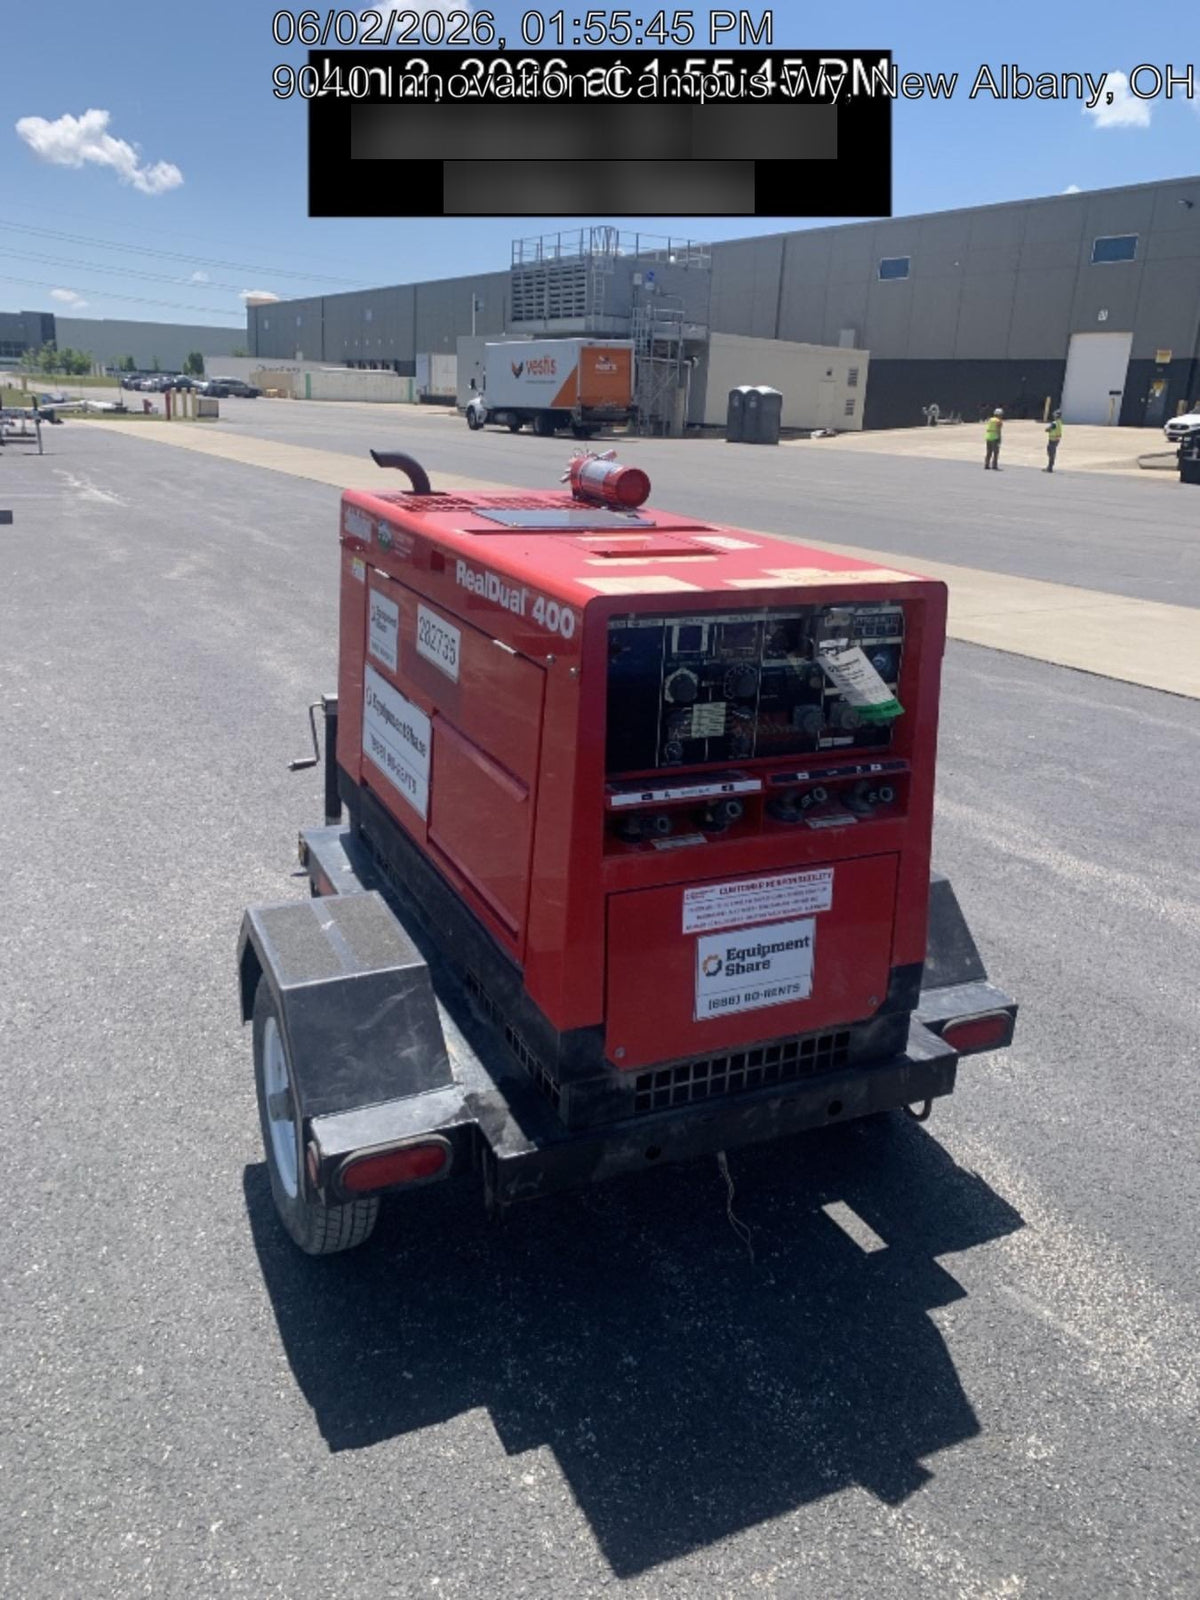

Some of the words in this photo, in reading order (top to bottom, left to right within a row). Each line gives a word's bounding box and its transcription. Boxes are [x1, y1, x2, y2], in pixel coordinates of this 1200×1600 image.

[456, 559, 527, 617] RealDual
[533, 596, 575, 639] 400
[419, 615, 456, 666] 282735
[726, 935, 811, 962] Equipment
[725, 960, 771, 977] Share
